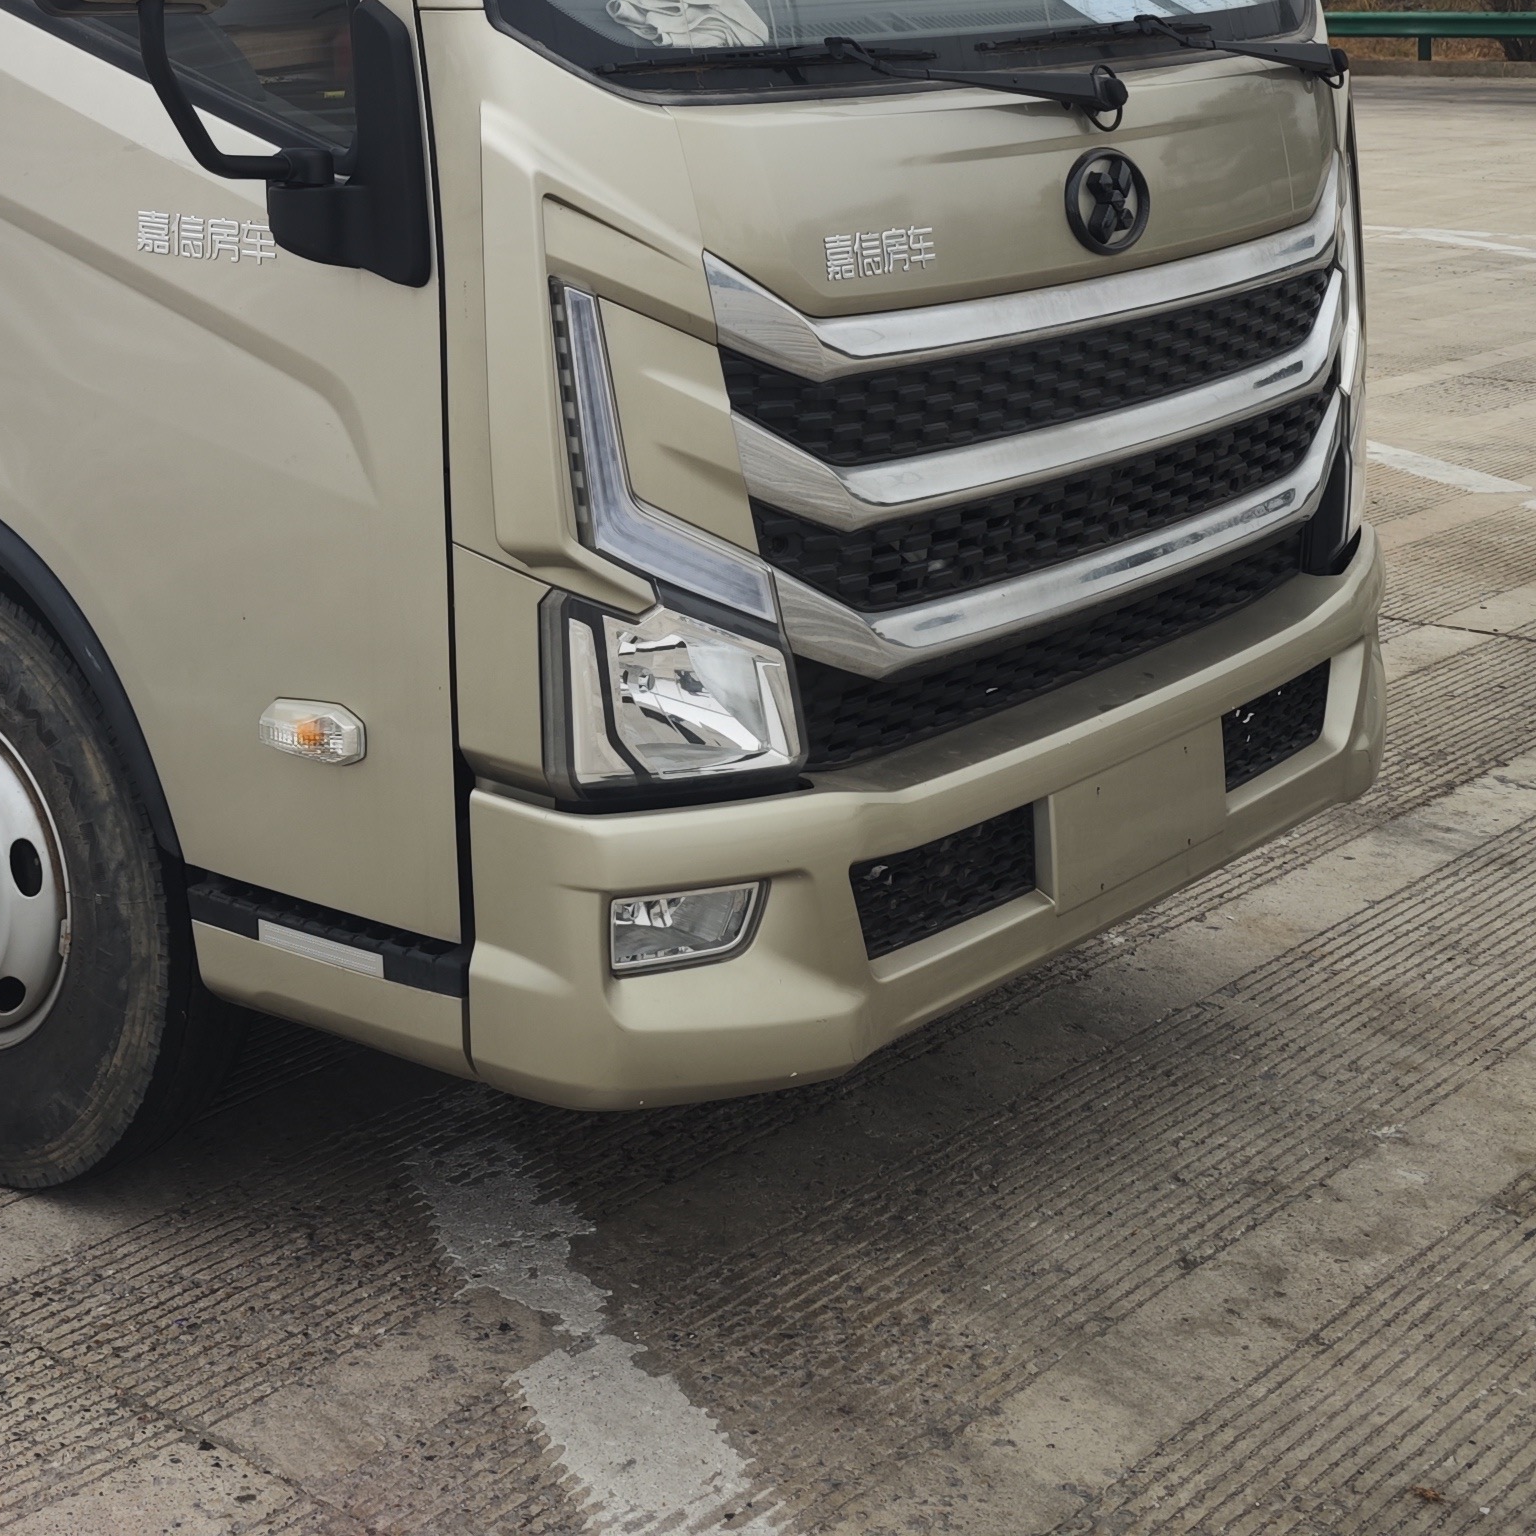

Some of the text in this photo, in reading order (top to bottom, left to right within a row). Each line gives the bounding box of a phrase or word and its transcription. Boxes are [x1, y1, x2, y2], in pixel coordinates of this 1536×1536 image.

[137, 210, 278, 266] 嘉信房车
[824, 225, 936, 282] 嘉信房车
